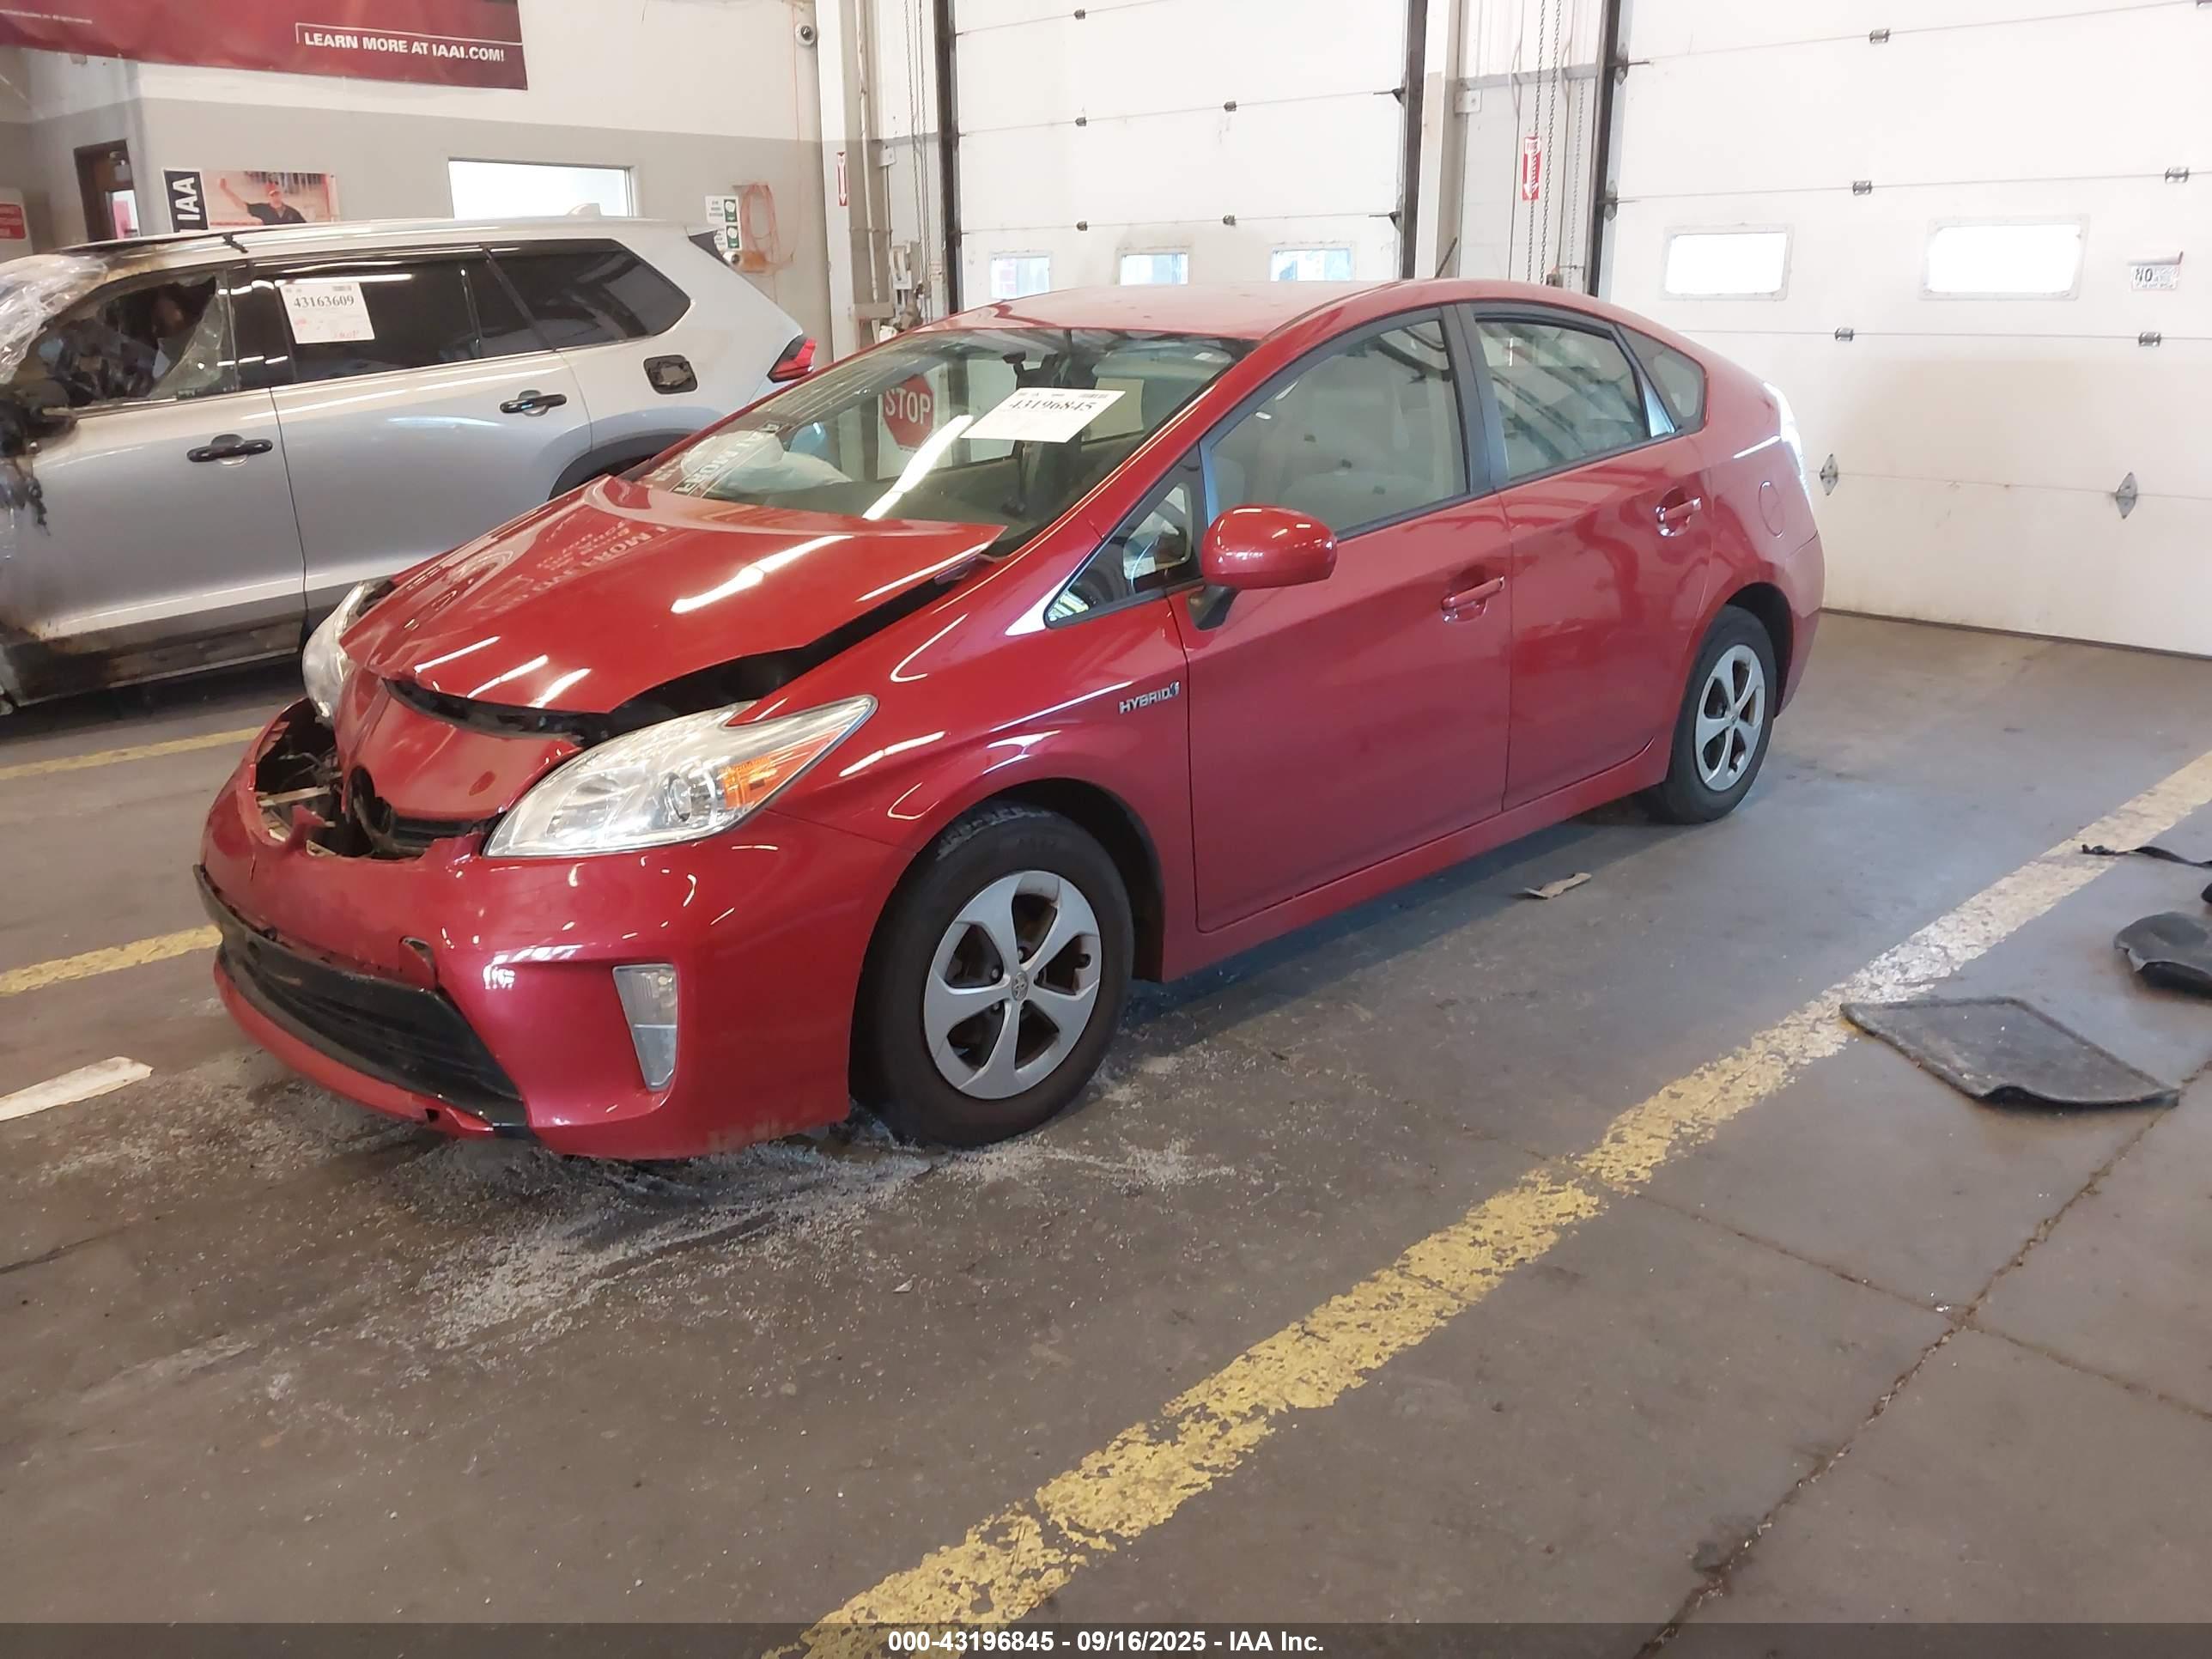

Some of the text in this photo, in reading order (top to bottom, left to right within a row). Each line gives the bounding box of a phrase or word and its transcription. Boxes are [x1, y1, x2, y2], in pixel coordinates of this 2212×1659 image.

[305, 32, 505, 62] LEARN MORE AT IAAI.COM!
[172, 177, 201, 221] IAA
[294, 295, 355, 308] 43163609
[884, 387, 931, 425] STOP
[1009, 399, 1097, 411] 43196845
[1119, 687, 1170, 714] HYBRID
